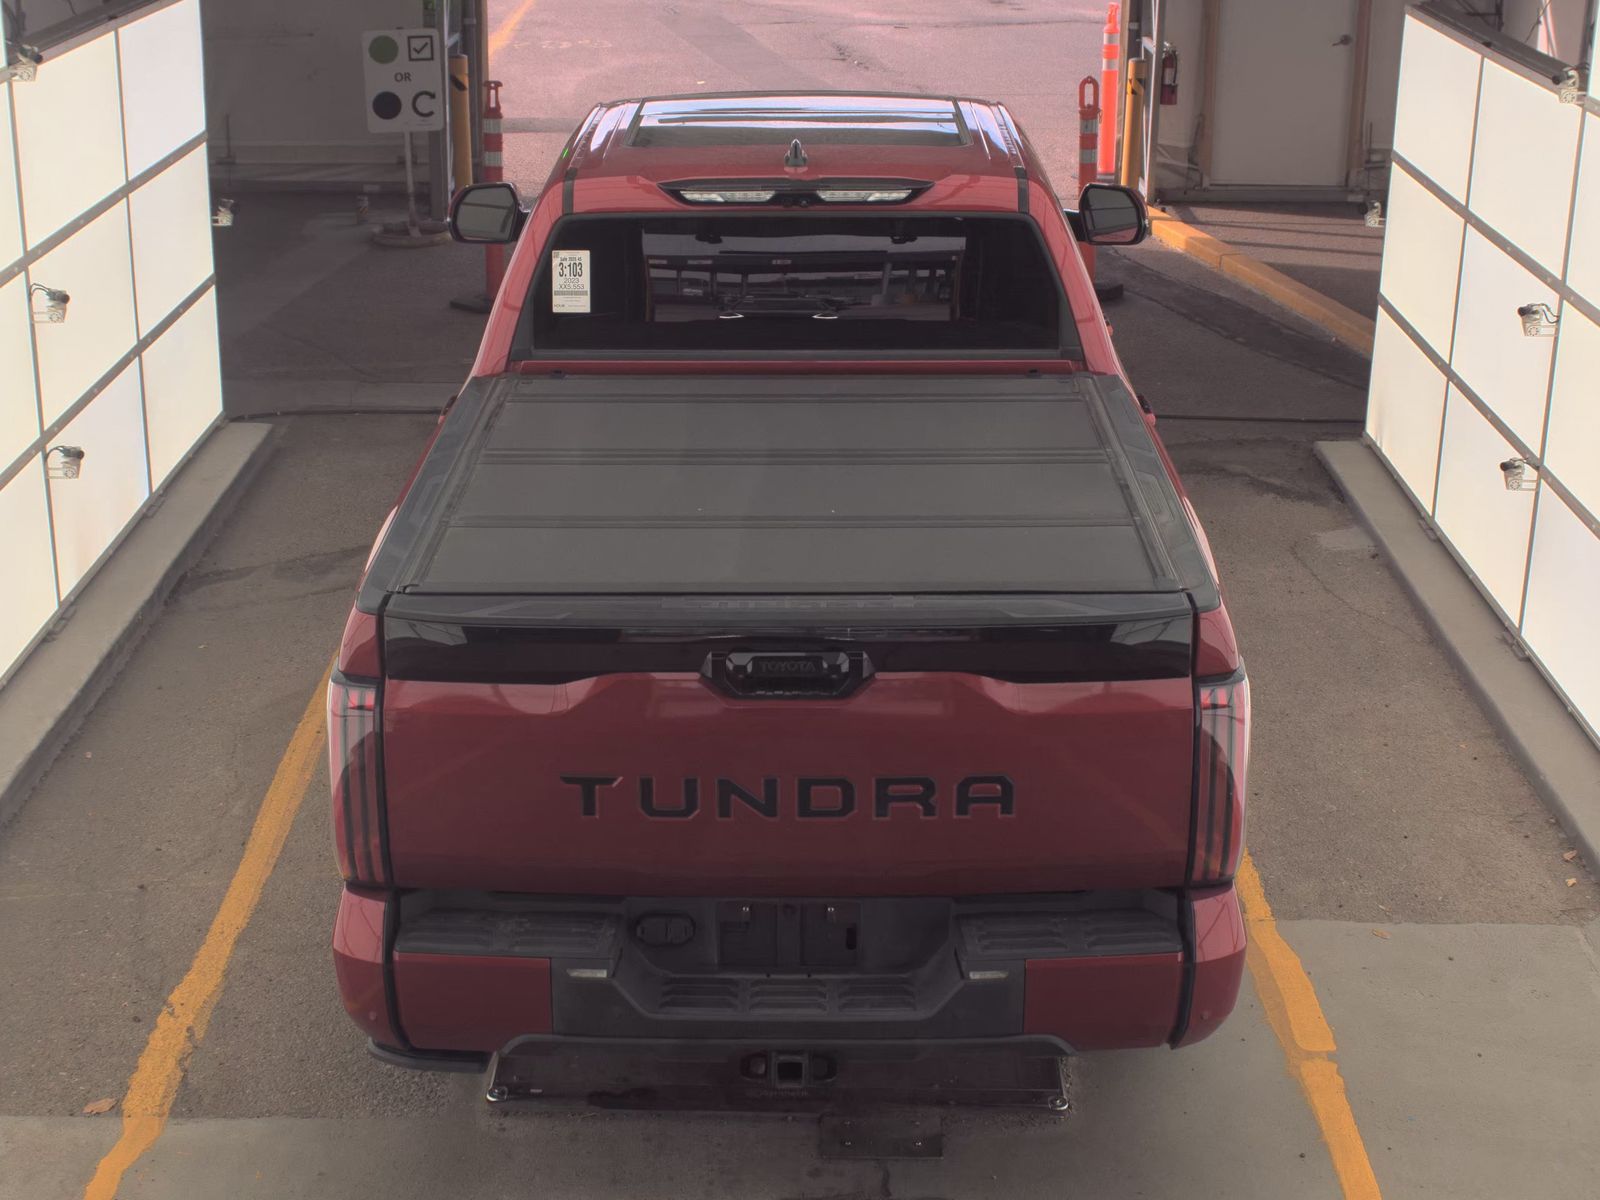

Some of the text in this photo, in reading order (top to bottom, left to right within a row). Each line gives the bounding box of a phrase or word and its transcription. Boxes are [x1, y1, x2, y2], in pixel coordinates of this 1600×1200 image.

[394, 72, 412, 82] OR
[558, 262, 583, 278] 3:103
[759, 660, 817, 674] TOYOTA
[560, 774, 1017, 820] TUNDRA
